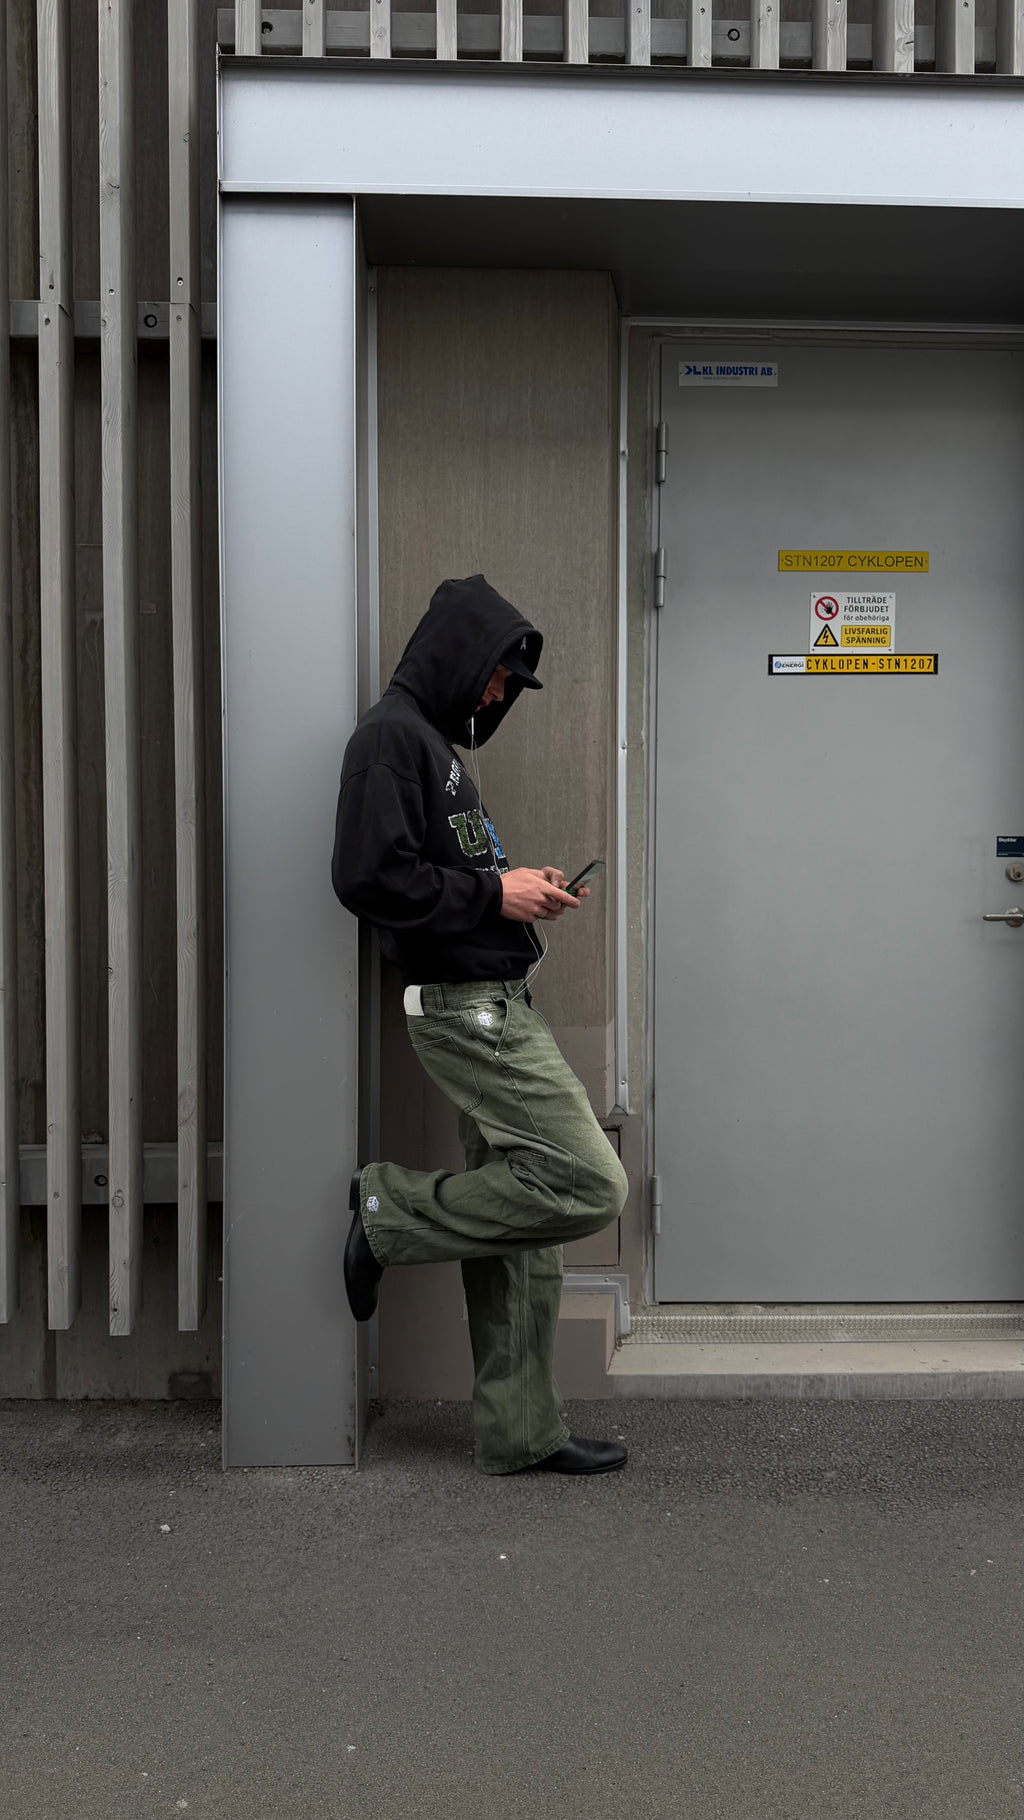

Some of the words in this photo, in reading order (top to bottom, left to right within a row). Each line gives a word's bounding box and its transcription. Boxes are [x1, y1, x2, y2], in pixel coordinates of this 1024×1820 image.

[702, 366, 713, 376] KL
[716, 366, 758, 376] INDUSTRI
[760, 366, 773, 376] AB
[784, 555, 843, 567] STN1207
[847, 555, 924, 568] CYKLOPEN
[846, 595, 887, 604] TILLTRÄDE
[844, 605, 889, 613] FÖRBJUDET
[855, 614, 889, 622] obehöriga
[844, 627, 888, 635] LIVSFARLIG
[846, 636, 886, 645] SPÄNNING
